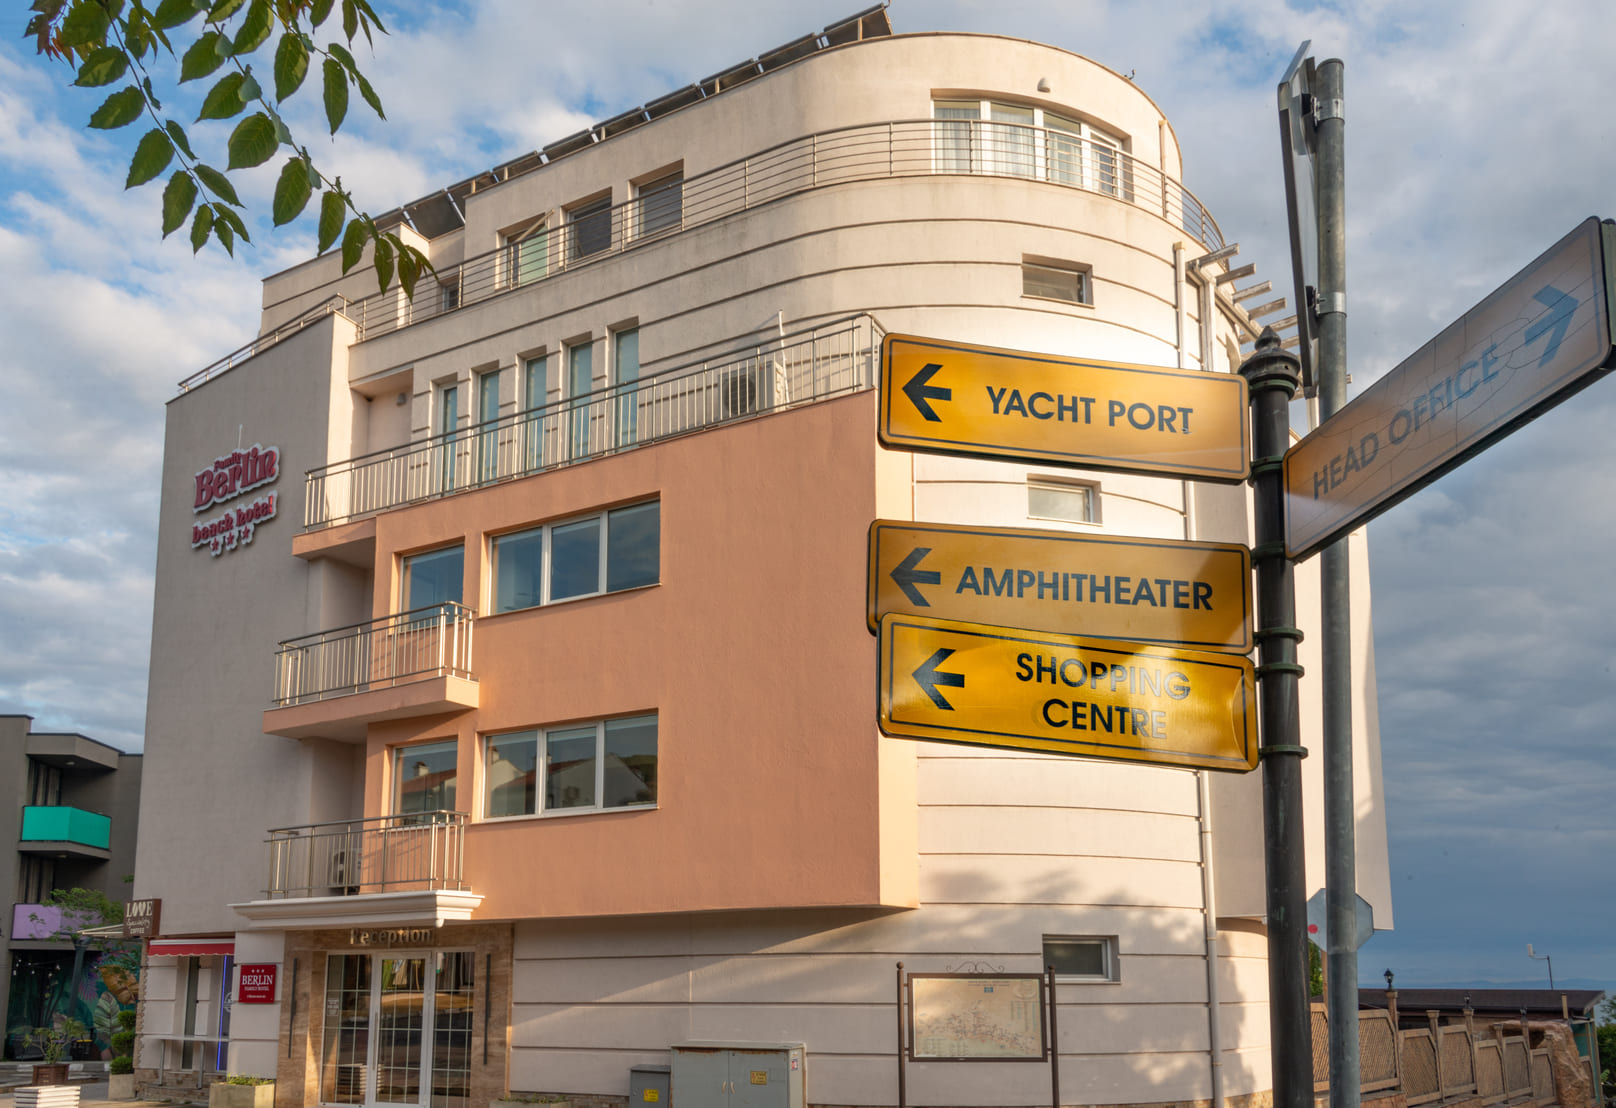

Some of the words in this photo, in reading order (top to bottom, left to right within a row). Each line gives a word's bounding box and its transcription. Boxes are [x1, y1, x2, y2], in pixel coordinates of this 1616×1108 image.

[985, 385, 1096, 426] YACHT
[1108, 400, 1194, 435] PORT
[1313, 431, 1380, 501] HEAD
[1387, 343, 1500, 447] OFFICE
[194, 447, 276, 509] Berlin
[192, 513, 234, 544] beach
[236, 494, 274, 527] hotel
[955, 566, 1214, 611] AMPHITHEATER
[1015, 653, 1192, 701] SHOPPING
[1042, 698, 1168, 740] CENTRE
[126, 900, 153, 918] LOVE
[242, 974, 273, 986] BERLIN
